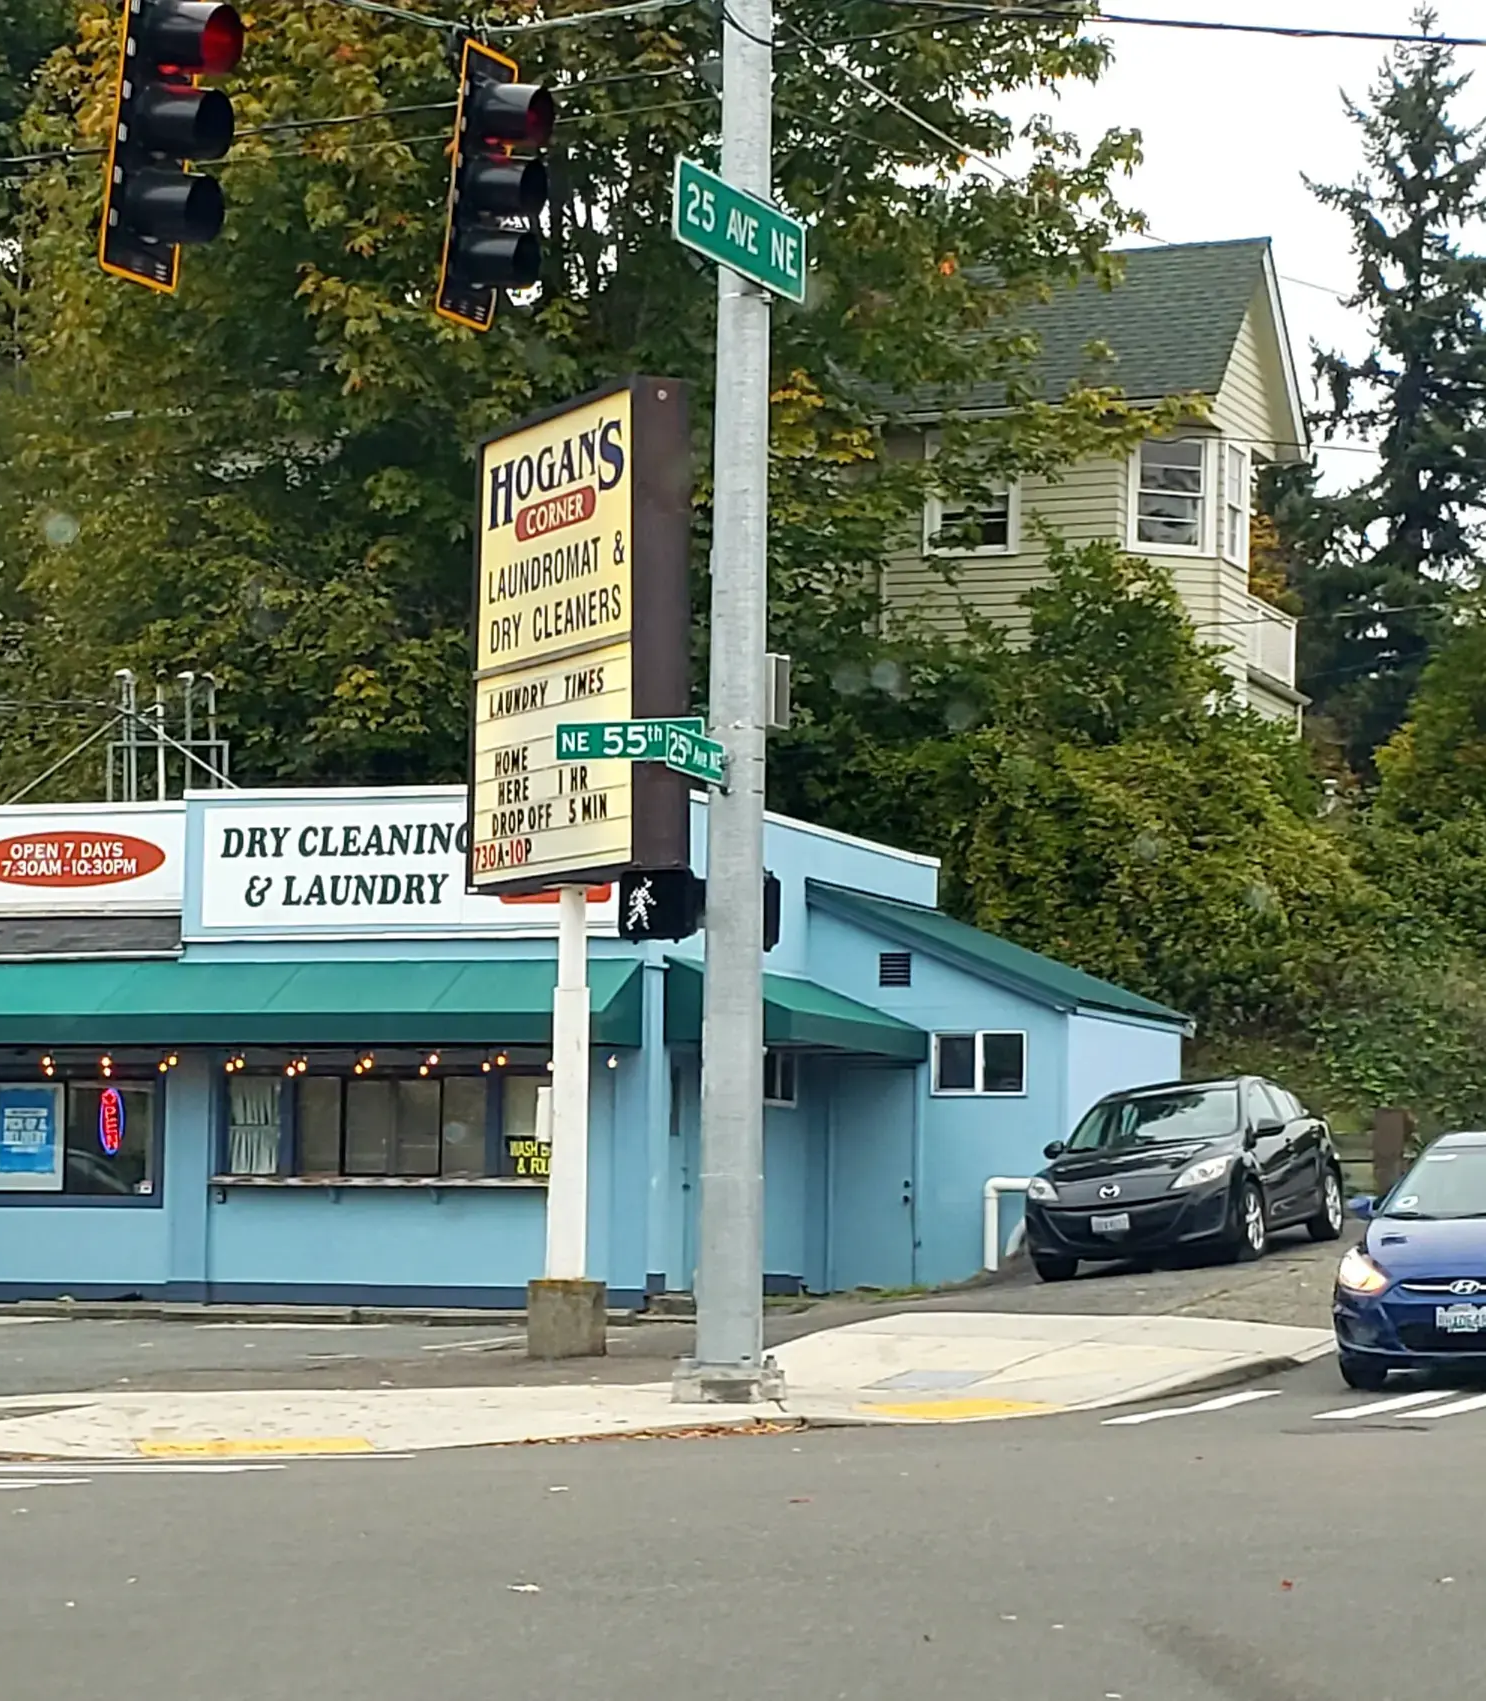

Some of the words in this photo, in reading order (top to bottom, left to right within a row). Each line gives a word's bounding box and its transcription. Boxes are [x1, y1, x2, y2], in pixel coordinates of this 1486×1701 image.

[686, 181, 716, 233] 25
[725, 207, 760, 256] AVE
[770, 227, 799, 279] NE
[487, 416, 625, 532] HOGAN'S
[525, 492, 585, 536] CORNER
[488, 536, 602, 606] LAUNDROMAT
[612, 530, 626, 566] &
[489, 611, 523, 655] DRY
[532, 583, 622, 643] CLEANERS
[488, 680, 549, 719] LAUNDRY
[563, 666, 605, 701] TIMES
[560, 731, 591, 753] NE
[602, 724, 663, 756] 55th
[494, 746, 529, 778] HOME
[498, 776, 530, 806] HERE
[570, 765, 588, 793] HR
[568, 797, 577, 824] 5
[581, 793, 608, 821] MIN
[9, 842, 59, 860] OPEN
[63, 842, 76, 859] 7
[80, 841, 124, 858] DAYS
[220, 826, 292, 859] DRY
[244, 874, 273, 908] &
[281, 872, 450, 906] LAUNDRY
[509, 1141, 539, 1157] WASH
[516, 1157, 527, 1175] &
[530, 1157, 551, 1175] FOL
